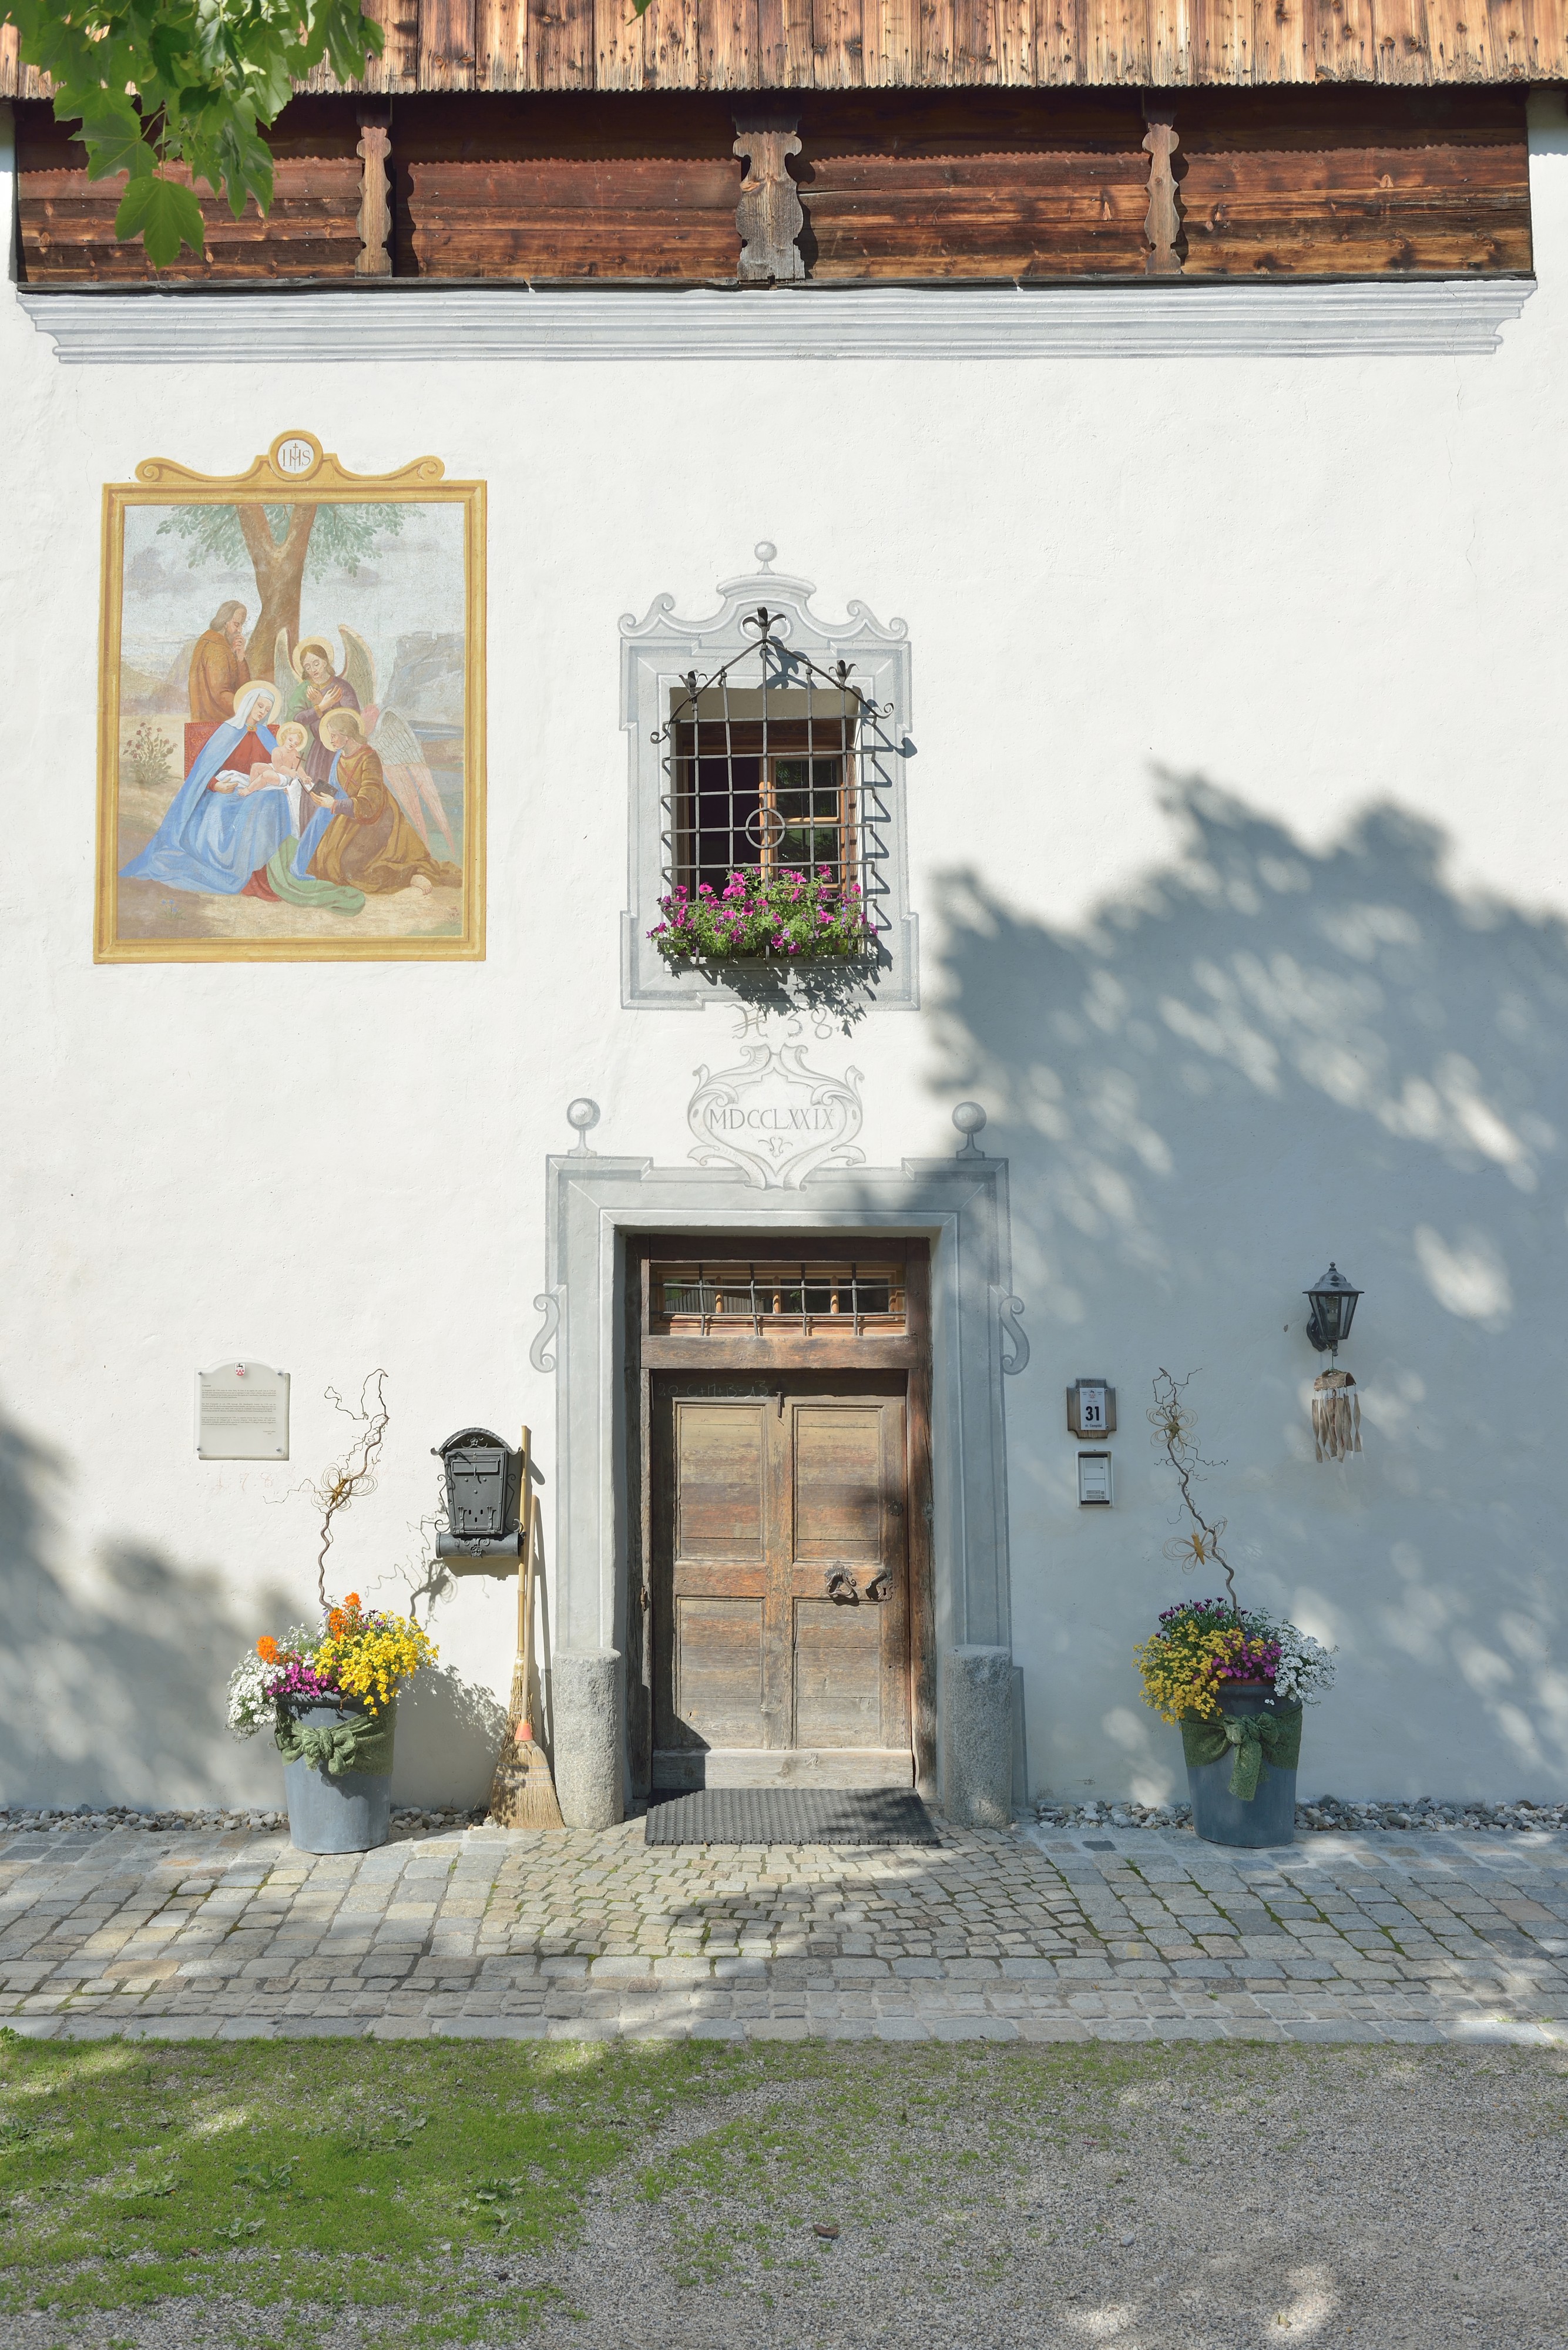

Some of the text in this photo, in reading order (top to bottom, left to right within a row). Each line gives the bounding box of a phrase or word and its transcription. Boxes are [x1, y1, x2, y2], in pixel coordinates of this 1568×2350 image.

[283, 444, 311, 469] IHS
[709, 1108, 834, 1129] MDCCLXXIX
[1086, 1406, 1099, 1421] 31
